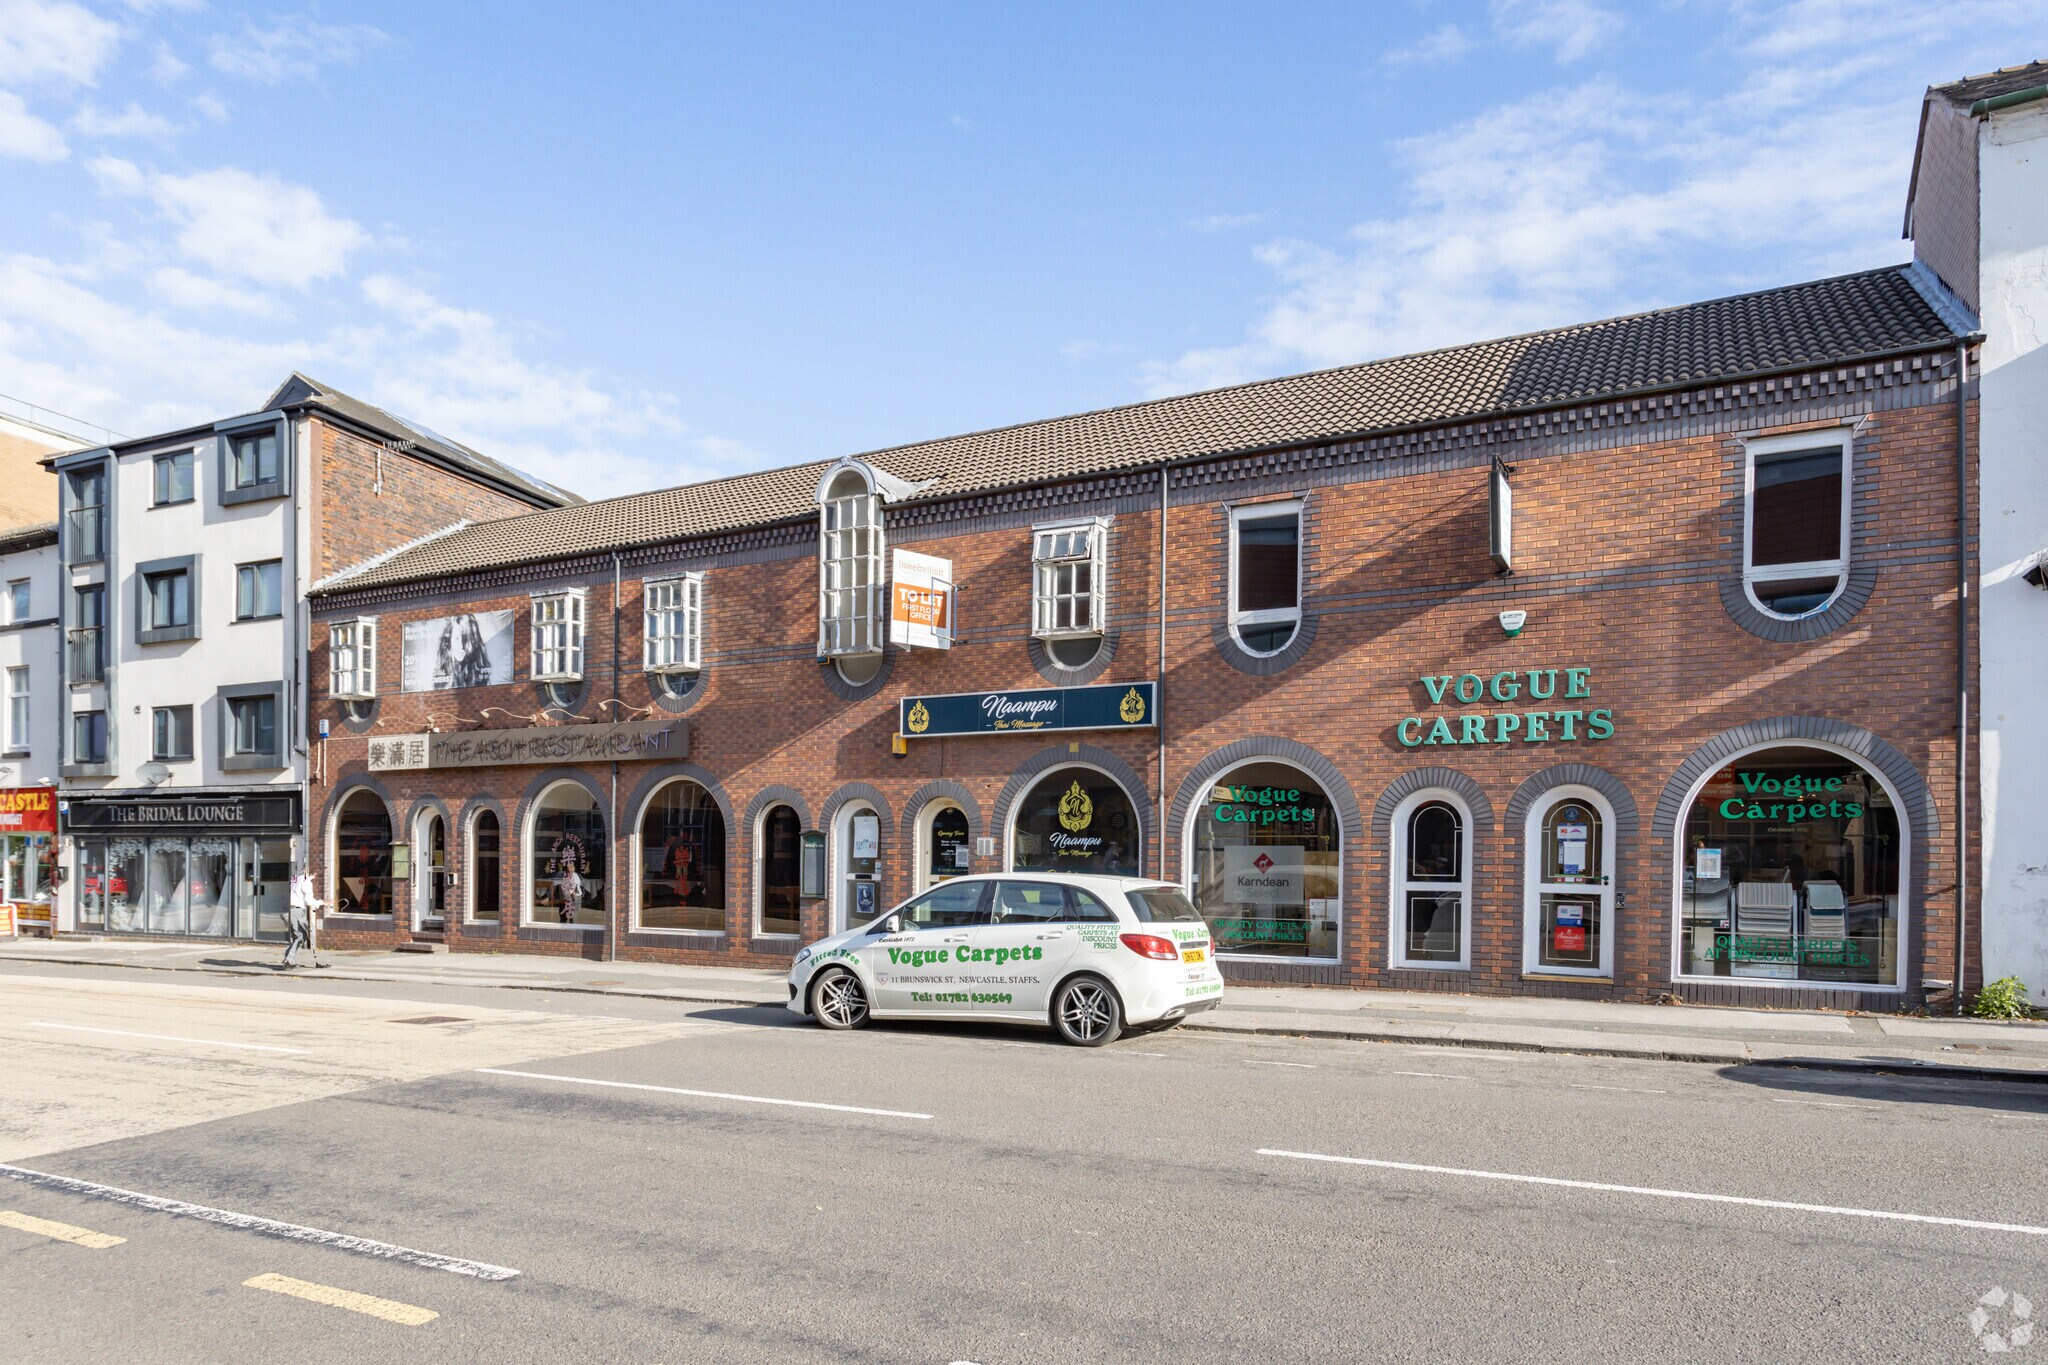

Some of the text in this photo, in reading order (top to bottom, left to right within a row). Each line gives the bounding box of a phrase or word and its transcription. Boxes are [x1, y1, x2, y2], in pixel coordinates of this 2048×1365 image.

[898, 587, 944, 608] TO LET
[901, 602, 940, 616] FIRST FLOOR
[1420, 667, 1591, 705] VOGUE
[982, 695, 1058, 720] Naampu
[994, 719, 1045, 731] Thai Massage
[1397, 709, 1615, 747] CARPETS
[436, 729, 676, 763] THE ARCH RESTAURANT
[1738, 772, 1843, 797] Vogue
[0, 793, 49, 811] CASTLE
[1227, 784, 1300, 806] Vogue
[109, 805, 243, 821] THE BRIDAL LOUNGE
[1215, 804, 1315, 825] Carpets
[1719, 797, 1865, 823] Carpets
[1049, 832, 1102, 850] Naampu
[1070, 849, 1093, 858] Massage
[1238, 877, 1289, 887] Karndean
[1247, 888, 1280, 897] Select
[1214, 919, 1253, 929] QUALITY
[1256, 921, 1298, 930] CARPETS
[1172, 929, 1195, 941] Vogue
[1224, 931, 1304, 940] DISCOUNT PRICES
[1716, 936, 1858, 953] QUALITY CARPETS
[810, 948, 860, 967] Fitted Free
[888, 944, 1043, 967] Vogue Carpets
[1704, 947, 1870, 966] AT DISCOUNT PRICES
[900, 976, 943, 984] BRUNSWICK
[944, 976, 955, 984] ST,
[959, 976, 1007, 985] NEWCASTLE,
[1009, 976, 1040, 984] STAFFS.
[911, 992, 1012, 1004] Tel: 01782 630569
